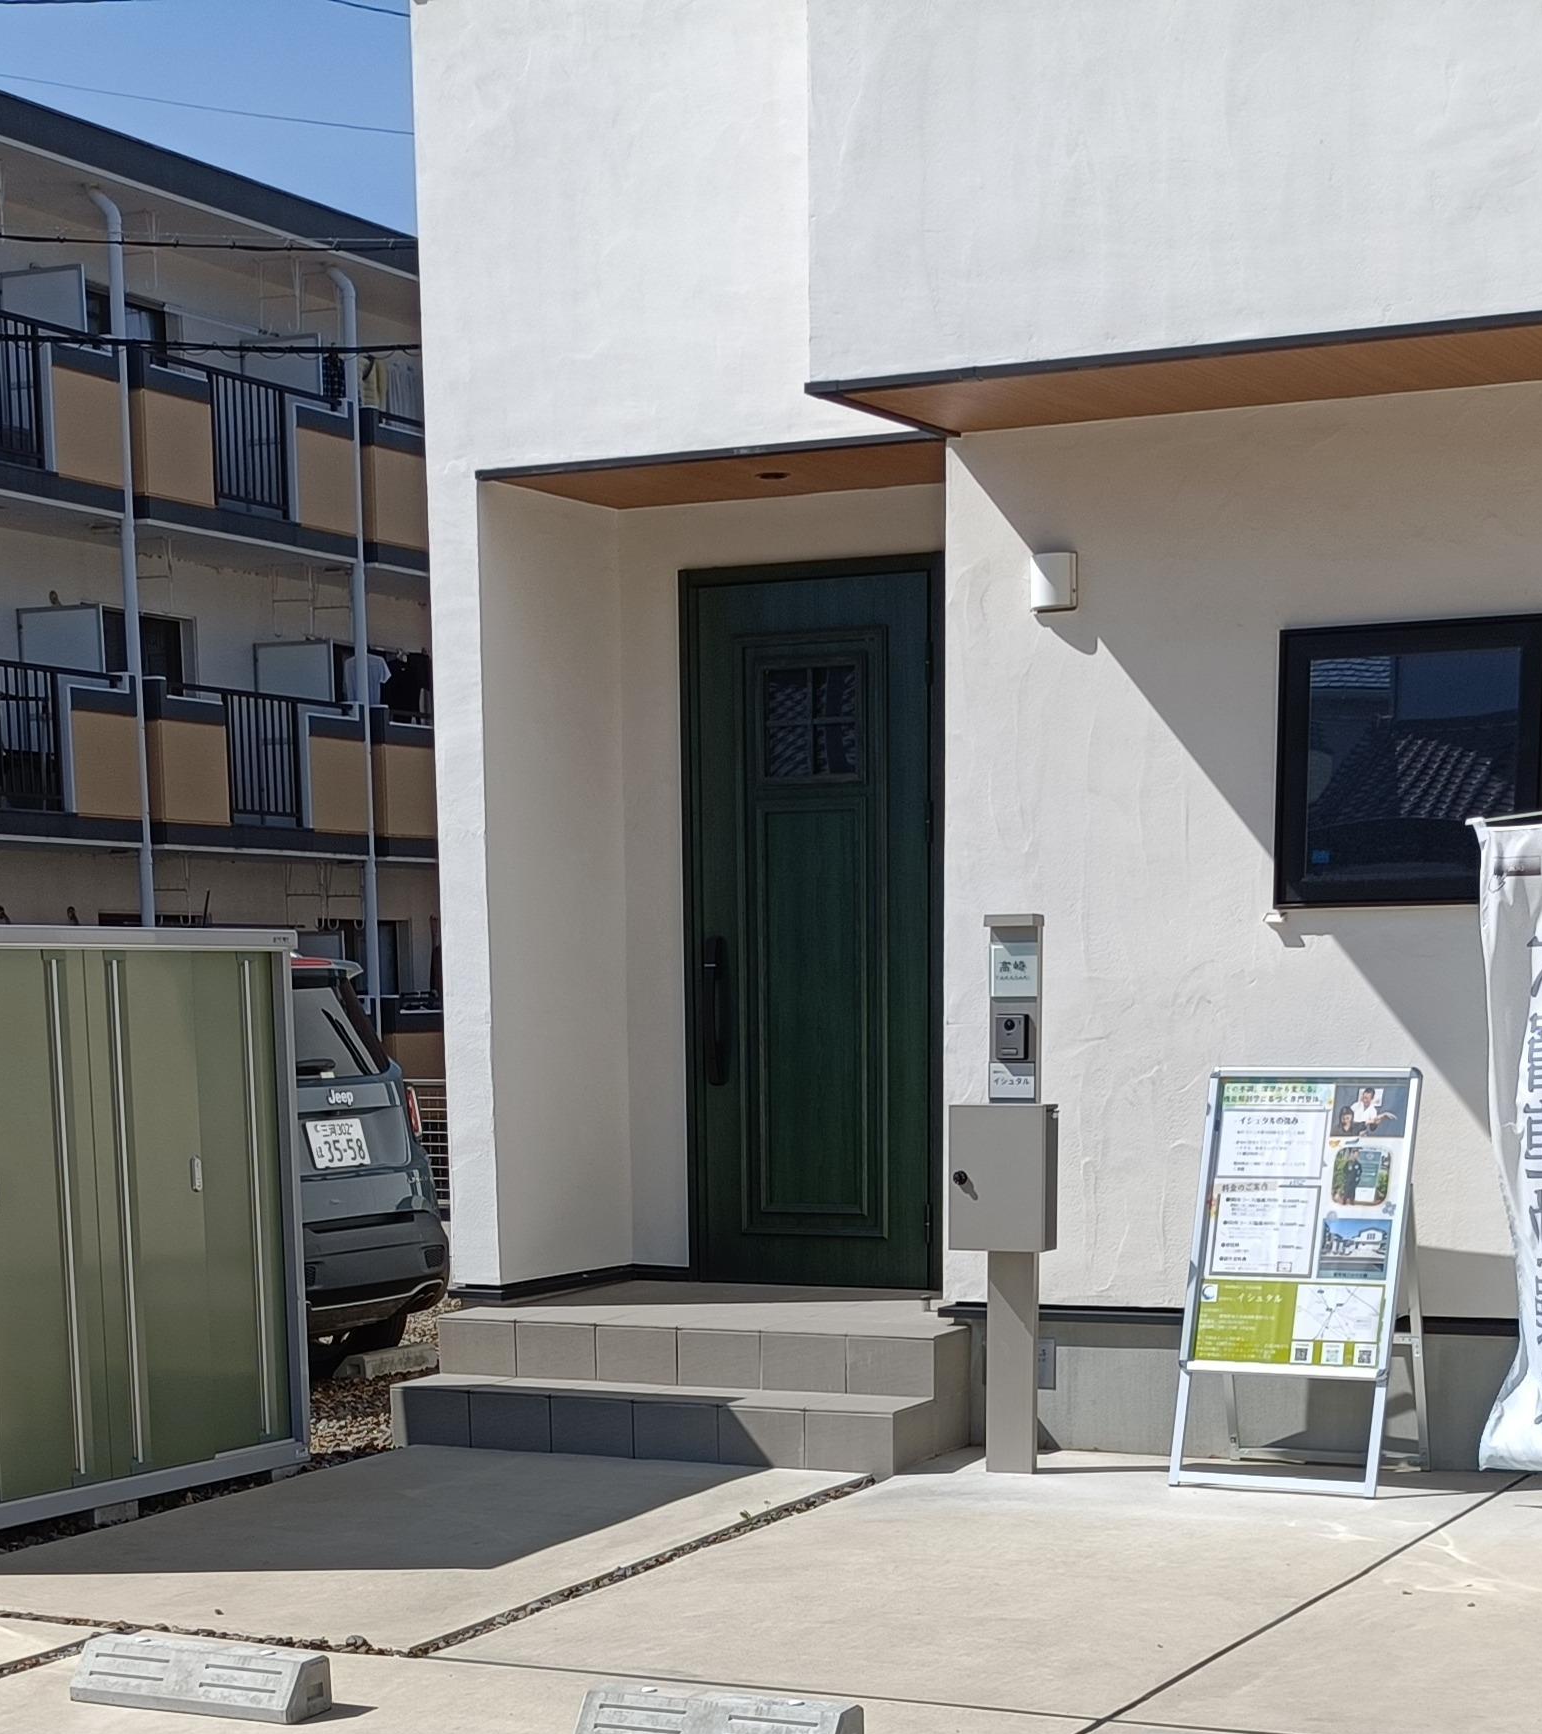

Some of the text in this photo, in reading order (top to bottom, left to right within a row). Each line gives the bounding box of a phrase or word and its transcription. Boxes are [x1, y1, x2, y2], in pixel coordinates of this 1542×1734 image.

[993, 1076, 1030, 1086] イシュタル
[327, 1089, 355, 1107] Jeep
[323, 1138, 367, 1163] 35-58
[1237, 1293, 1283, 1304] イシュタル
